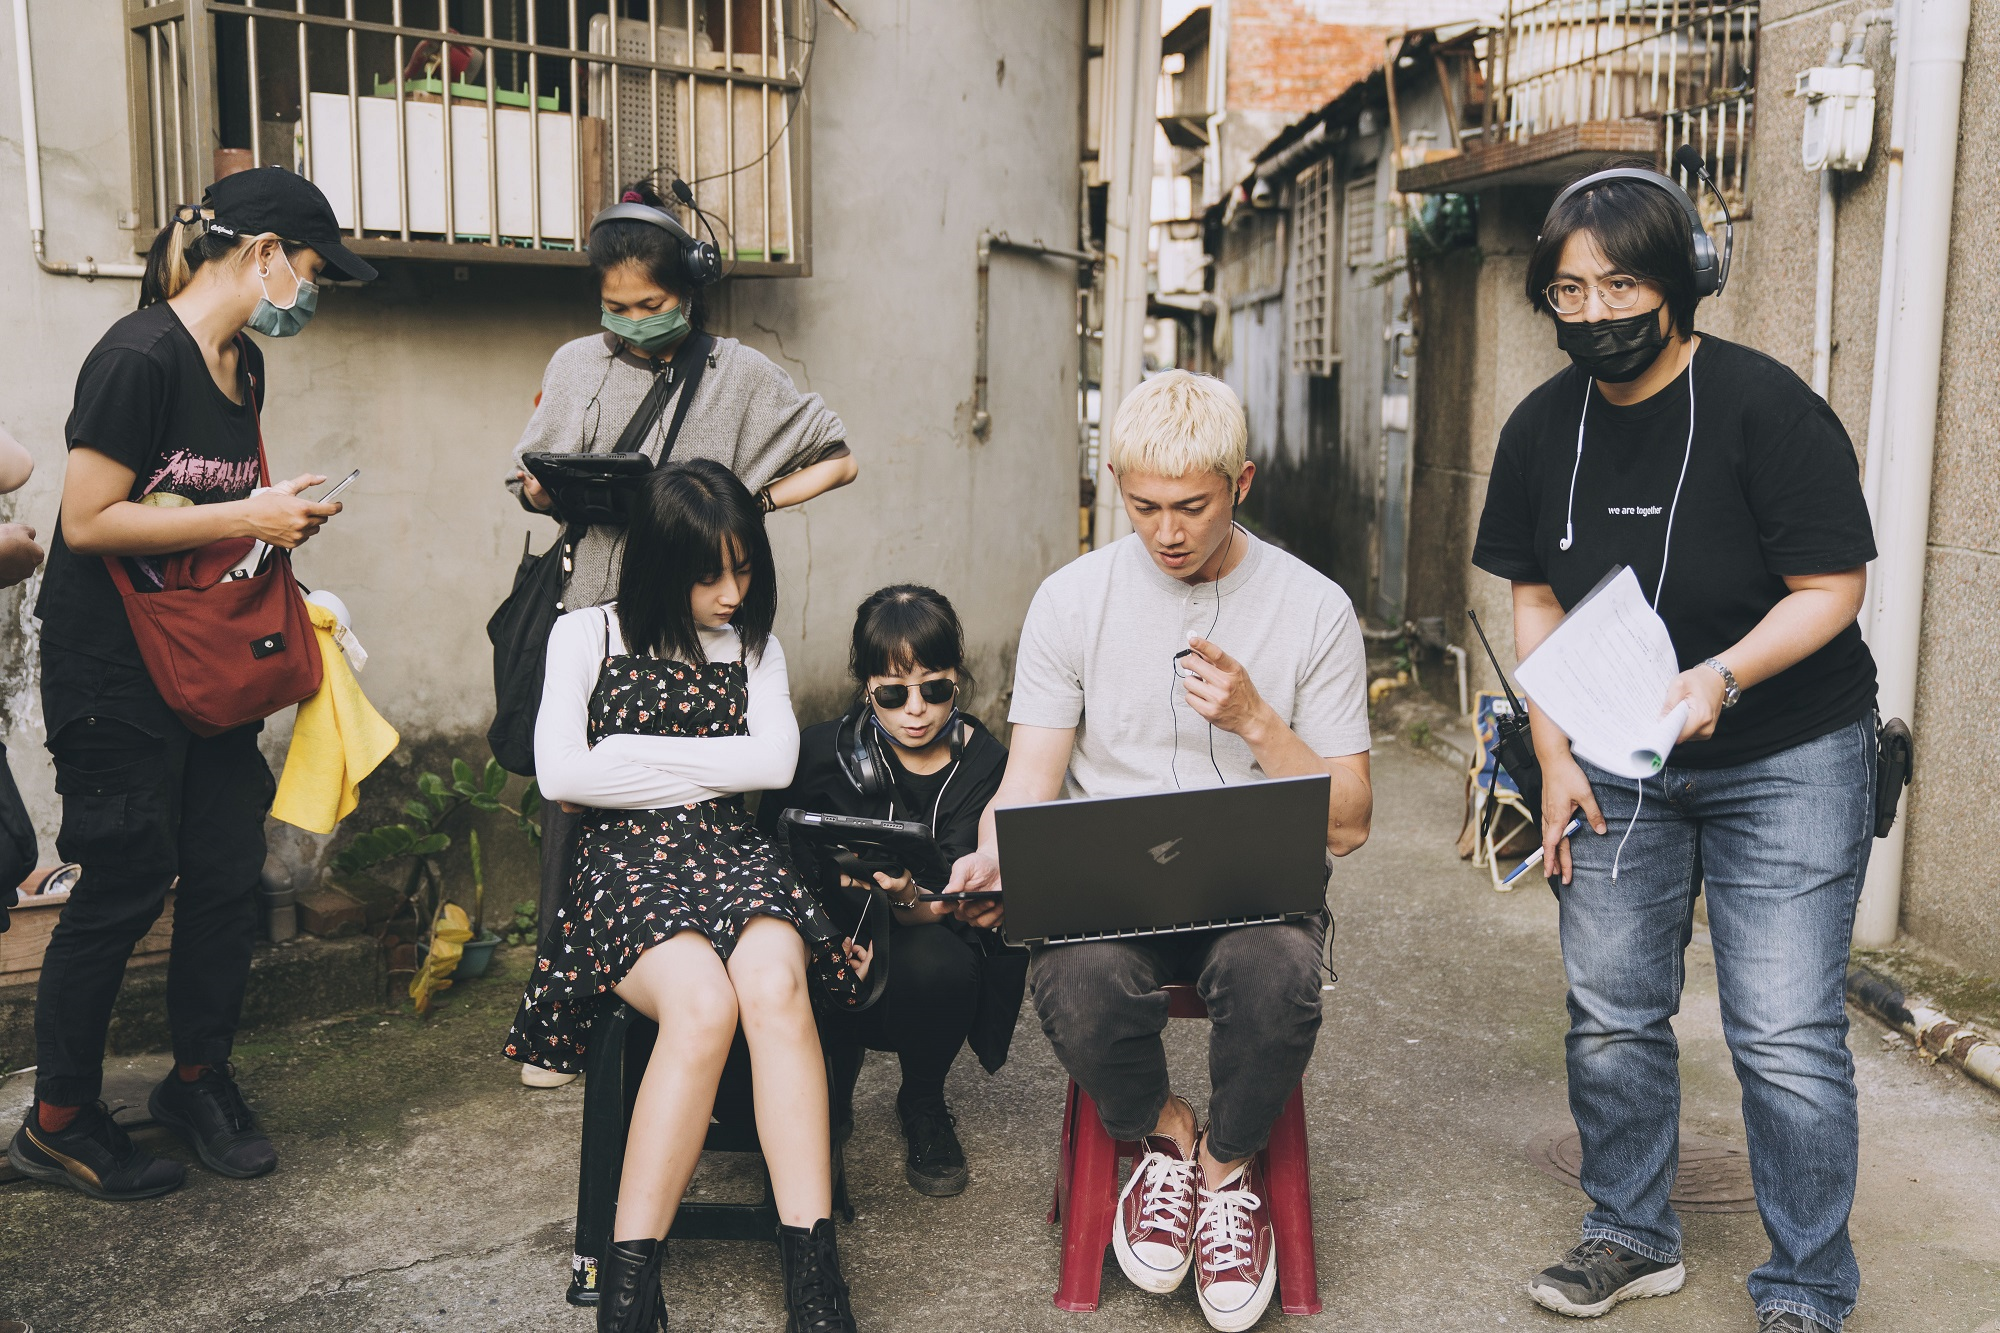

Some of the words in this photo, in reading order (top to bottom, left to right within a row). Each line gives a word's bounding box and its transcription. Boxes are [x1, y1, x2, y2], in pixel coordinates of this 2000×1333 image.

[136, 450, 259, 502] METALLIC
[1621, 507, 1635, 515] are
[1636, 505, 1662, 517] together
